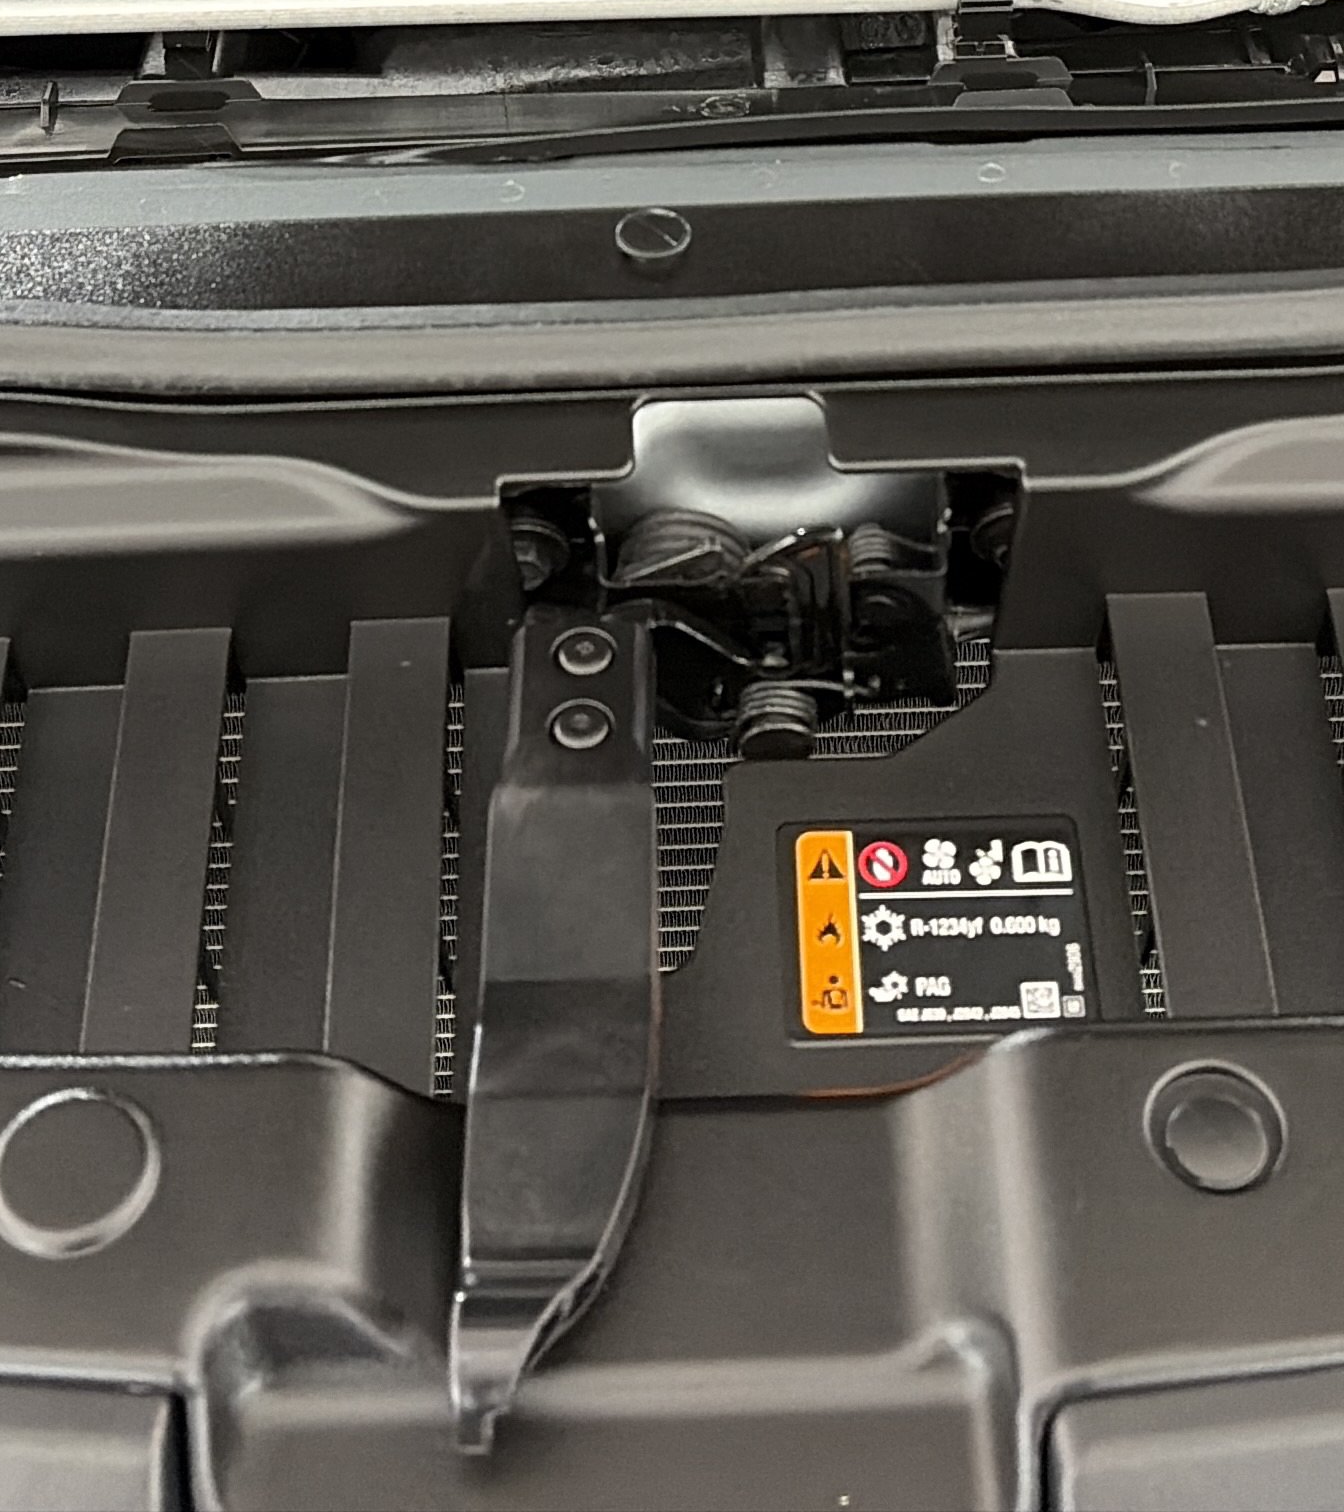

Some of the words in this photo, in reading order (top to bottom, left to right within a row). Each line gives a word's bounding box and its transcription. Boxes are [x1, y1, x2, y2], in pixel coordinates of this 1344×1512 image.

[922, 868, 961, 885] AUTO
[910, 917, 984, 939] R-1234yf
[1038, 915, 1061, 937] kg
[916, 977, 951, 997] PAG
